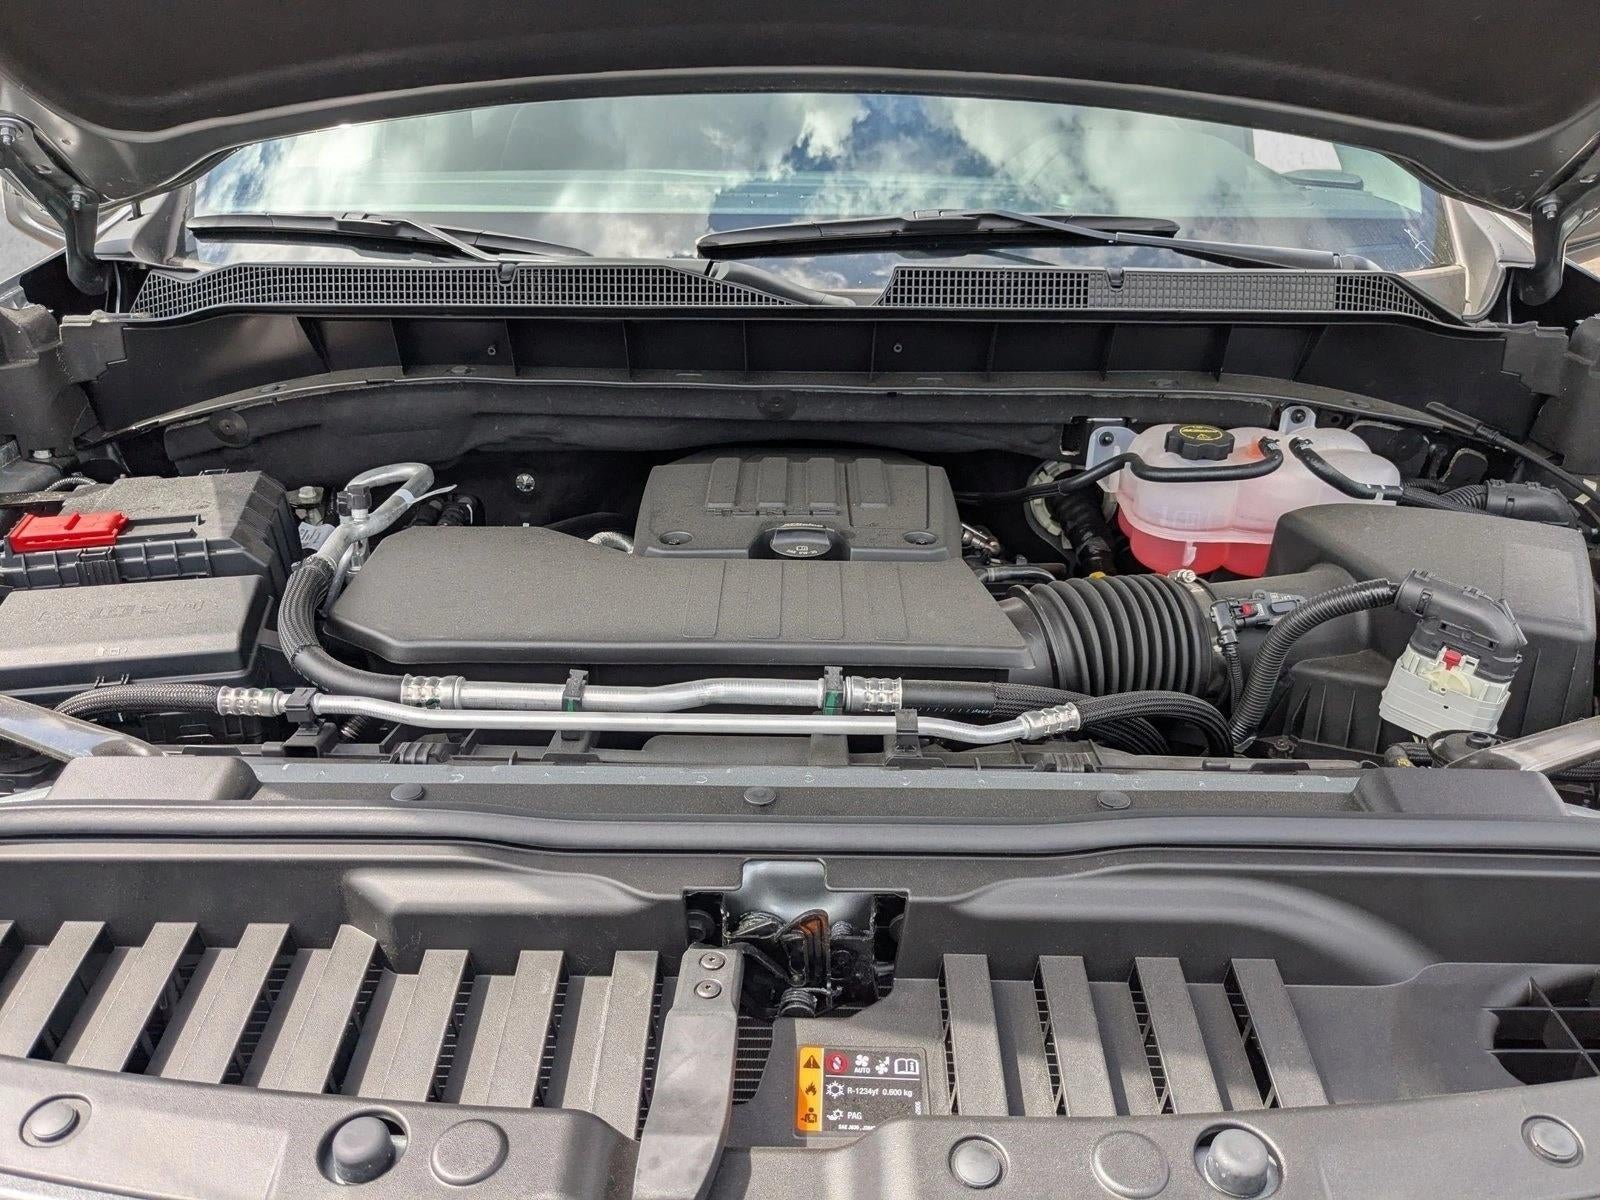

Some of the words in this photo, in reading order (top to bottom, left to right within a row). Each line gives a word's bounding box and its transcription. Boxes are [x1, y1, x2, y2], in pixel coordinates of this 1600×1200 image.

[847, 1087, 879, 1096] R-1234yf
[903, 1089, 913, 1097] kg
[847, 1112, 862, 1120] PAG
